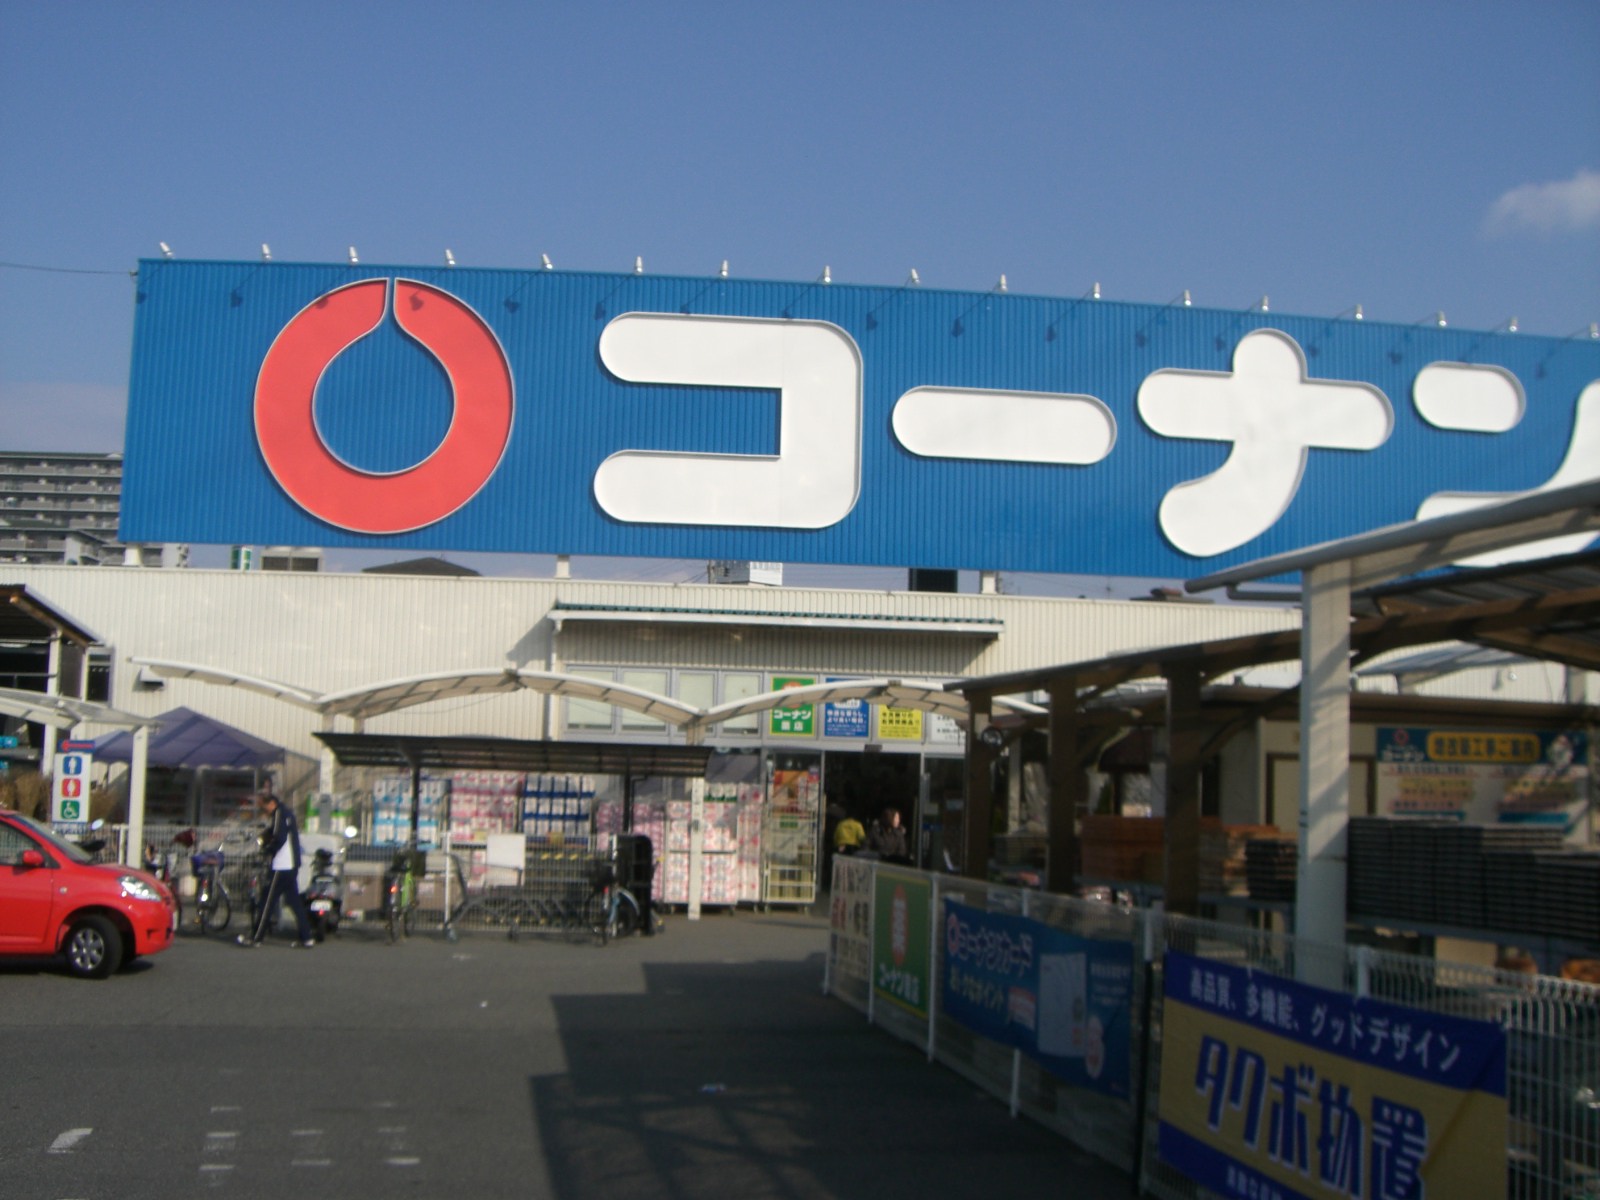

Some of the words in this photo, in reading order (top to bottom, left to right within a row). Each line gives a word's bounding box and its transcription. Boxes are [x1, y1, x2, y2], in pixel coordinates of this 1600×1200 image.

[594, 311, 1600, 568] コーナン
[774, 709, 812, 720] コーナン
